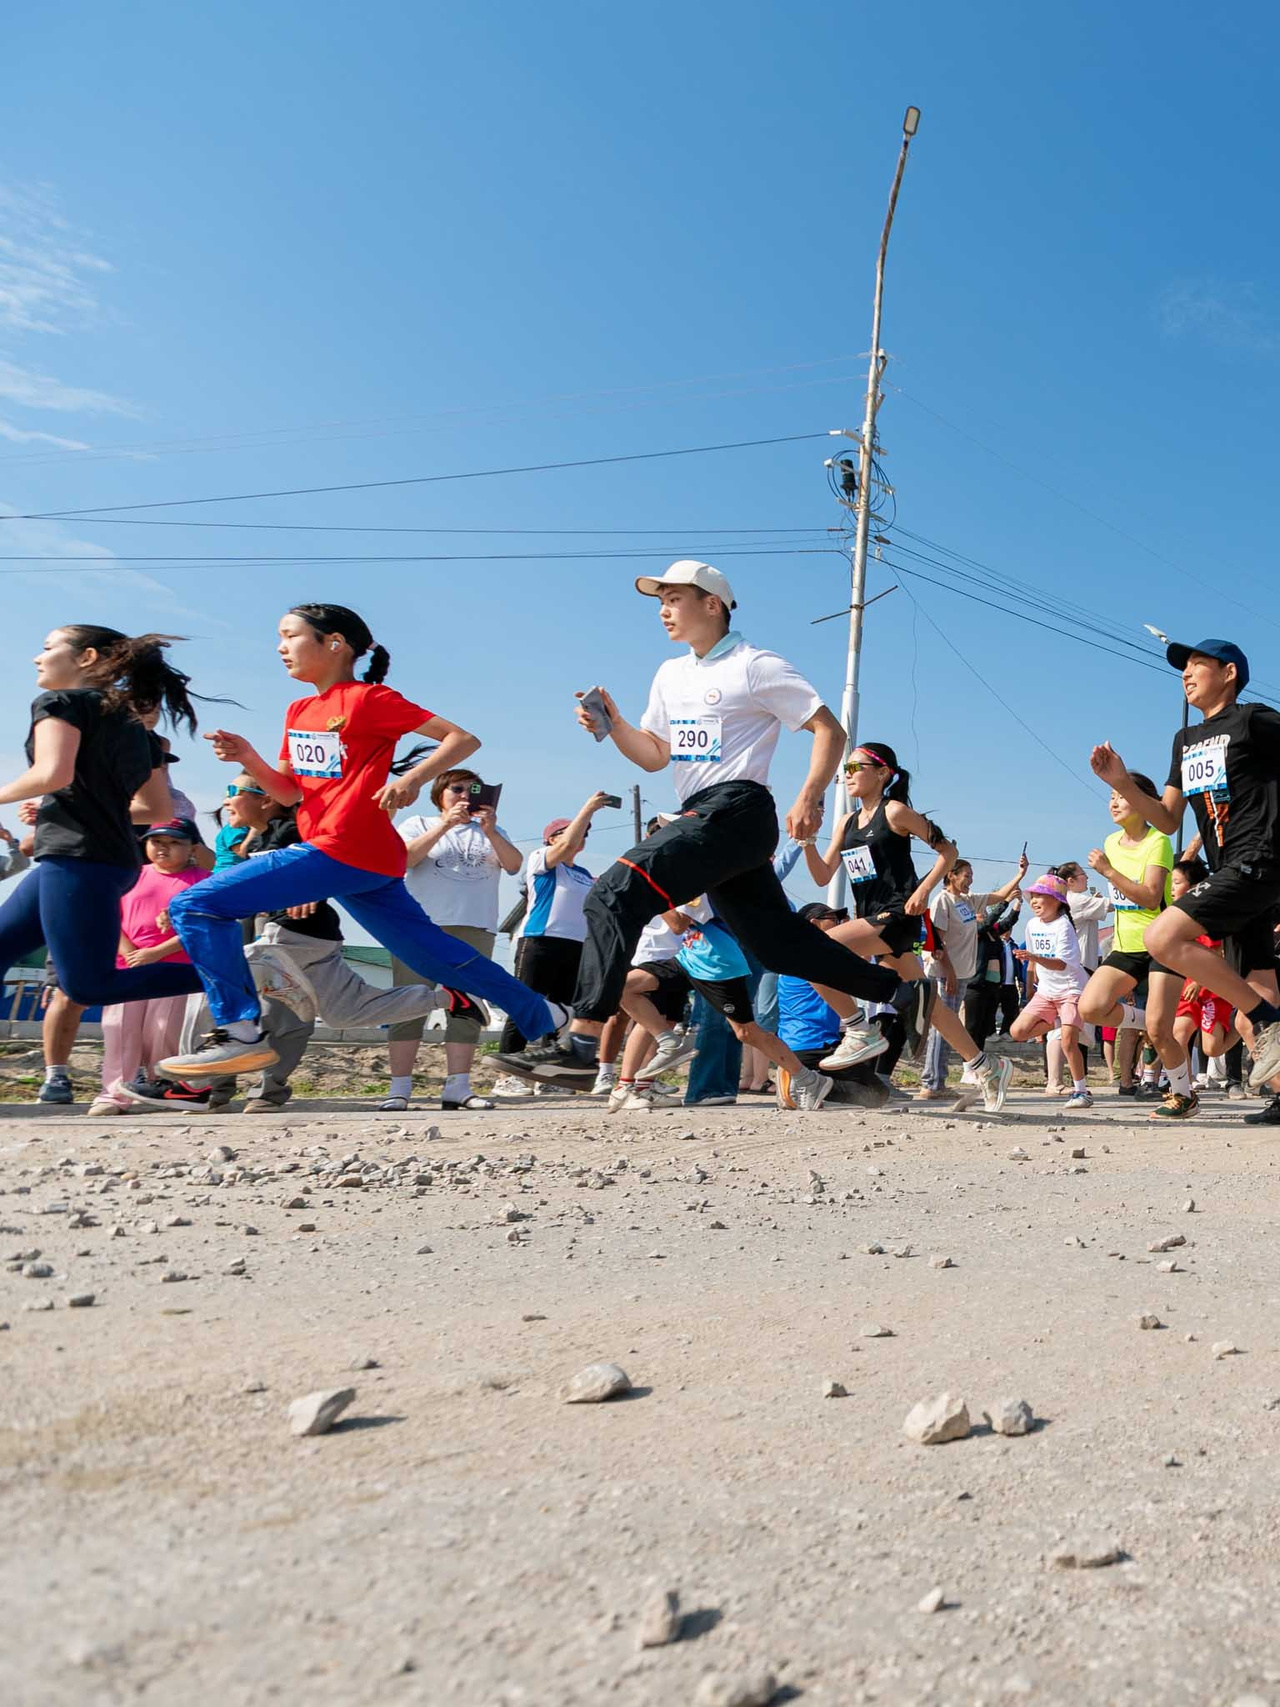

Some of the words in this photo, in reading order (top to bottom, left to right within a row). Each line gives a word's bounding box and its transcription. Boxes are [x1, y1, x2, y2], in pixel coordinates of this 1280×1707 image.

[678, 730, 708, 748] 290
[296, 743, 325, 764] 020
[1188, 760, 1215, 782] 005
[848, 856, 867, 874] 041
[1035, 939, 1051, 950] 065
